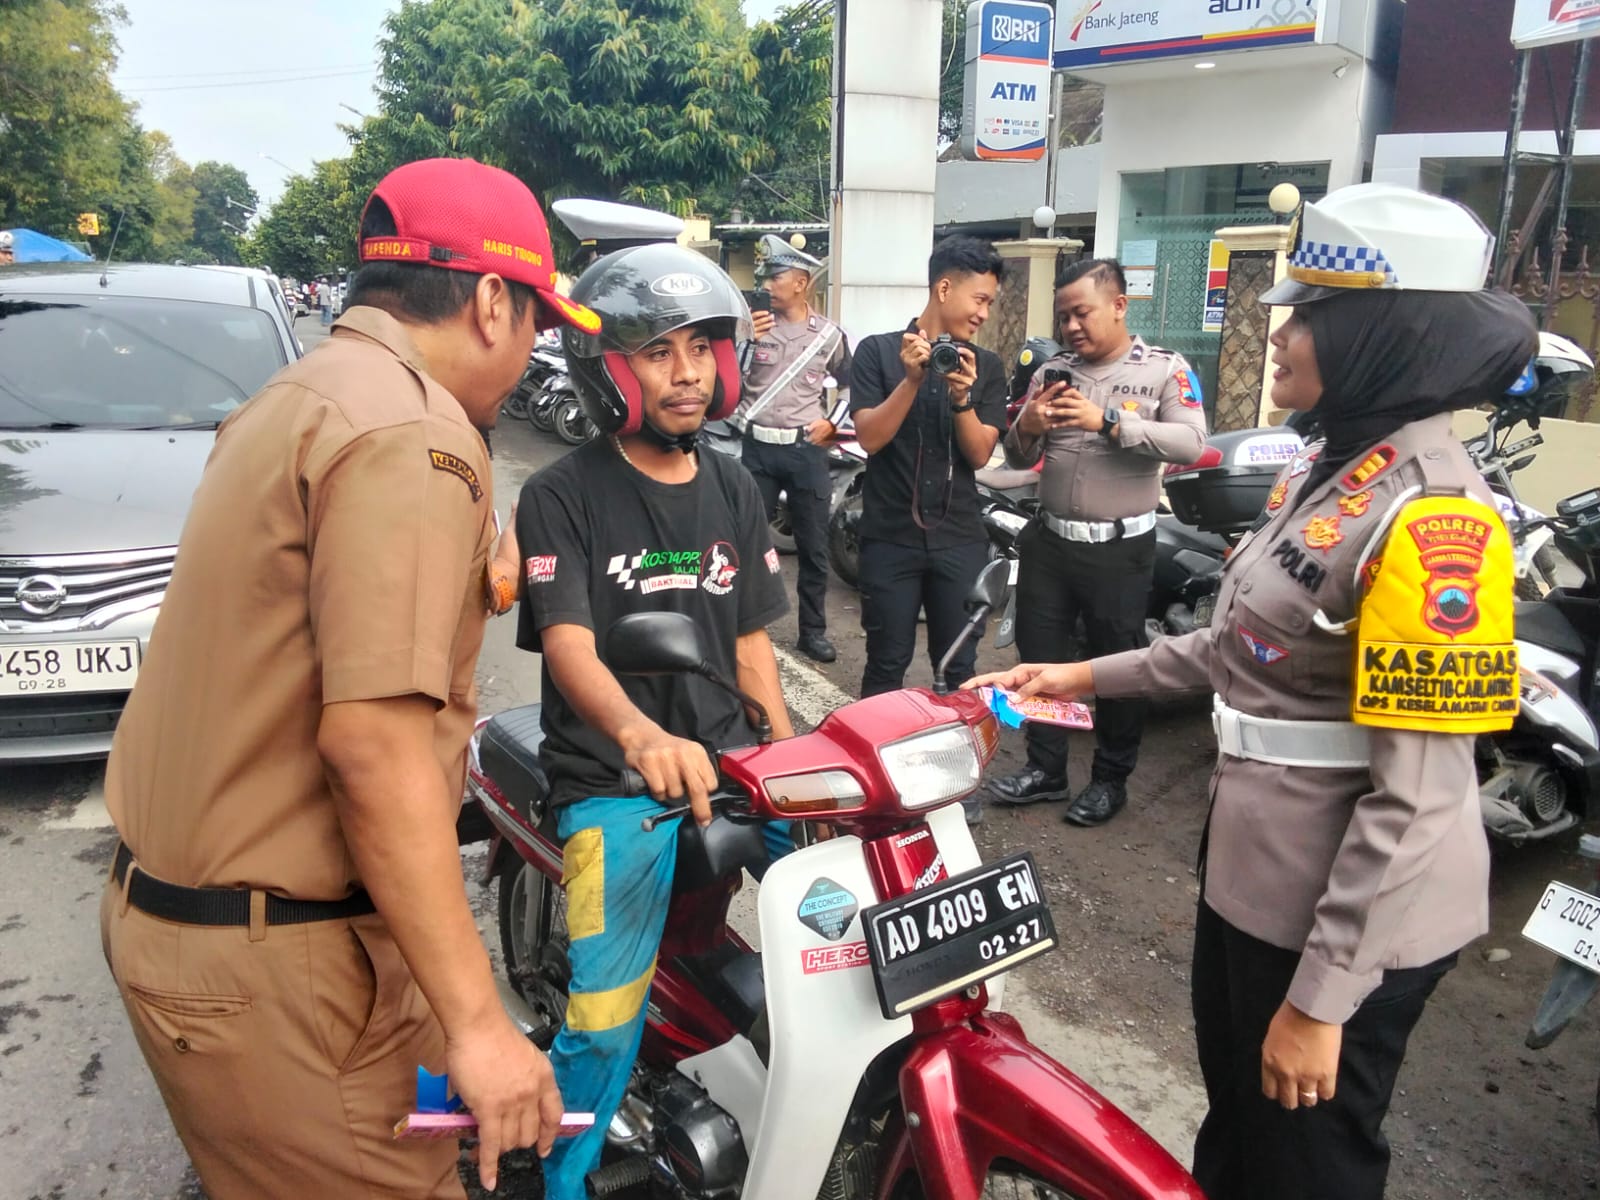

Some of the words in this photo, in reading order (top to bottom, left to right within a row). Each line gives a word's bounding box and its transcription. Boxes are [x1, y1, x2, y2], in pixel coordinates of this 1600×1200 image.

[1085, 15, 1116, 29] Bank
[1117, 10, 1159, 30] Jateng
[1011, 18, 1040, 43] BRI
[990, 82, 1037, 102] ATM
[483, 239, 513, 257] HARIS
[1112, 384, 1154, 397] POLRI
[1416, 518, 1486, 537] POLRES
[1271, 539, 1327, 593] POLRI
[0, 649, 60, 678] 458
[76, 646, 132, 674] UKJ
[1360, 695, 1389, 709] OPS
[896, 830, 930, 848] HONDA
[804, 901, 816, 912] THE
[817, 894, 848, 908] CONCEPT
[1540, 888, 1556, 911] G
[1559, 896, 1600, 931] 2002
[886, 914, 920, 960] AD
[926, 888, 988, 941] 4809
[996, 869, 1036, 911] EN
[806, 944, 870, 969] HERO
